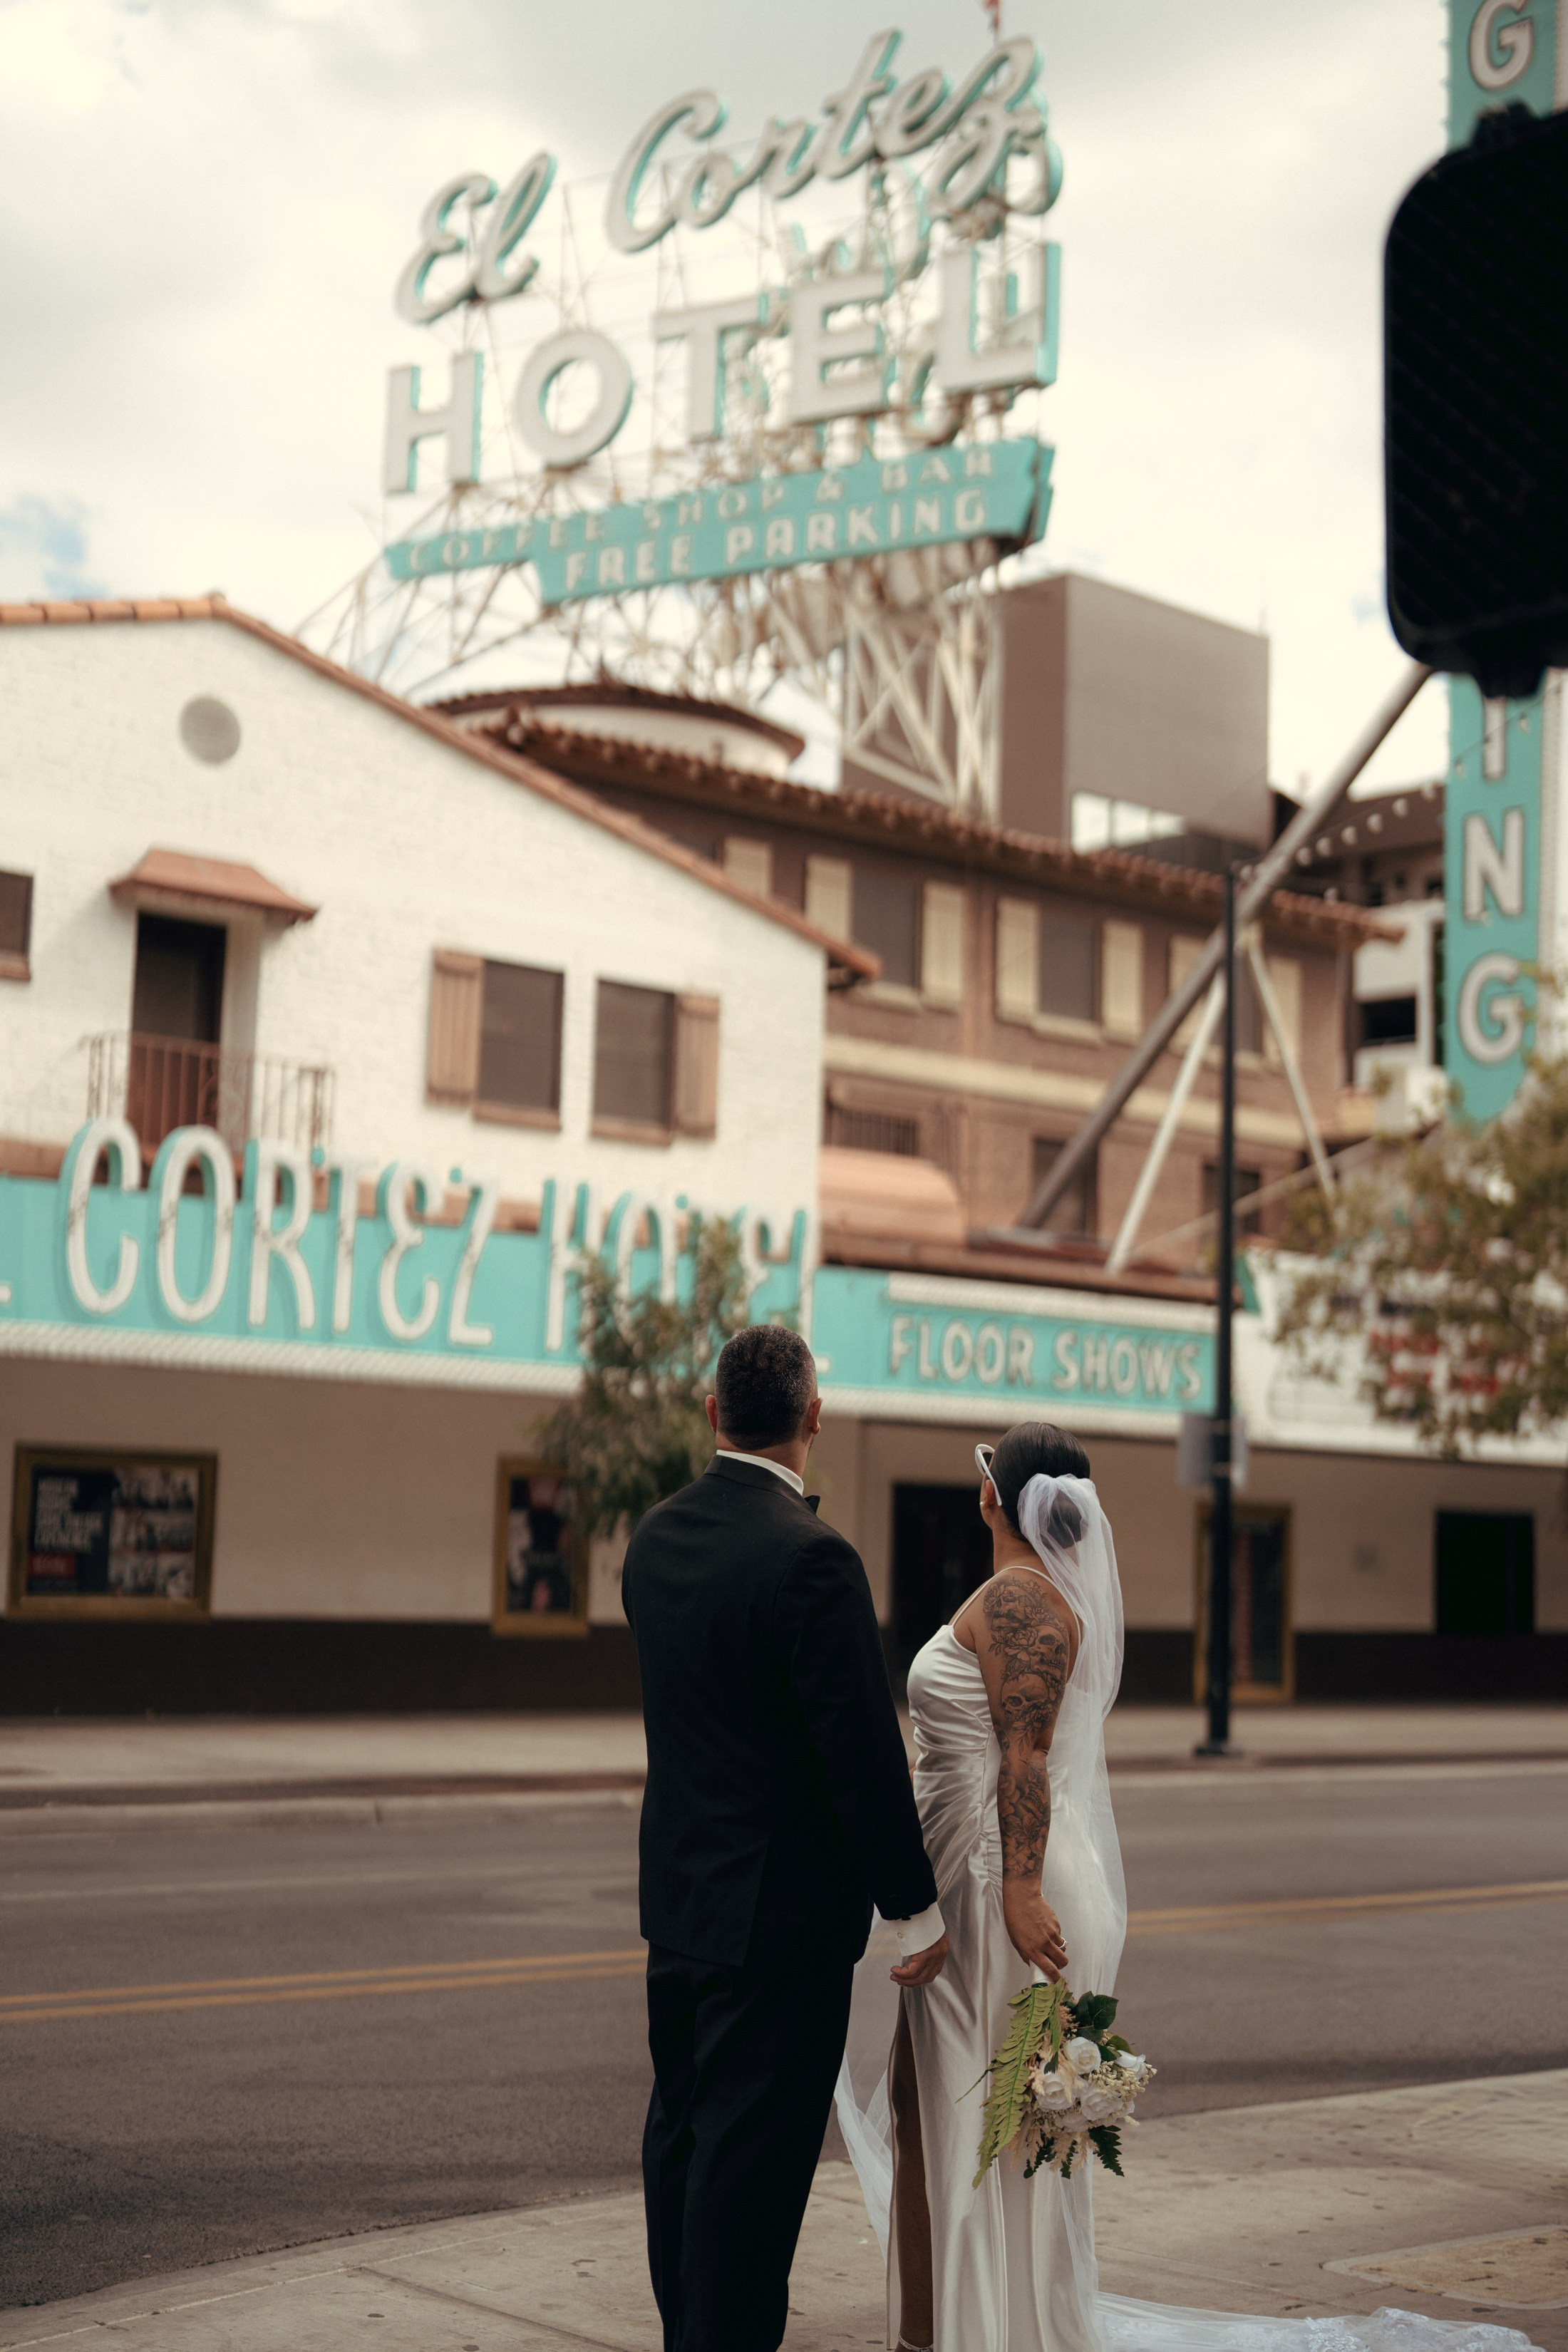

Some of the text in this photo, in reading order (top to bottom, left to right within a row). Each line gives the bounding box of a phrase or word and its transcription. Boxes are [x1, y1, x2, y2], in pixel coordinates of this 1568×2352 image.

[394, 29, 1048, 325] El Cortez
[383, 246, 1049, 493] HOTEL
[566, 488, 986, 592] FREE PARKING
[643, 479, 785, 531] SHOP
[64, 1116, 500, 1346] CORTEZ
[889, 1314, 1202, 1401] FLOOR SHOWS
